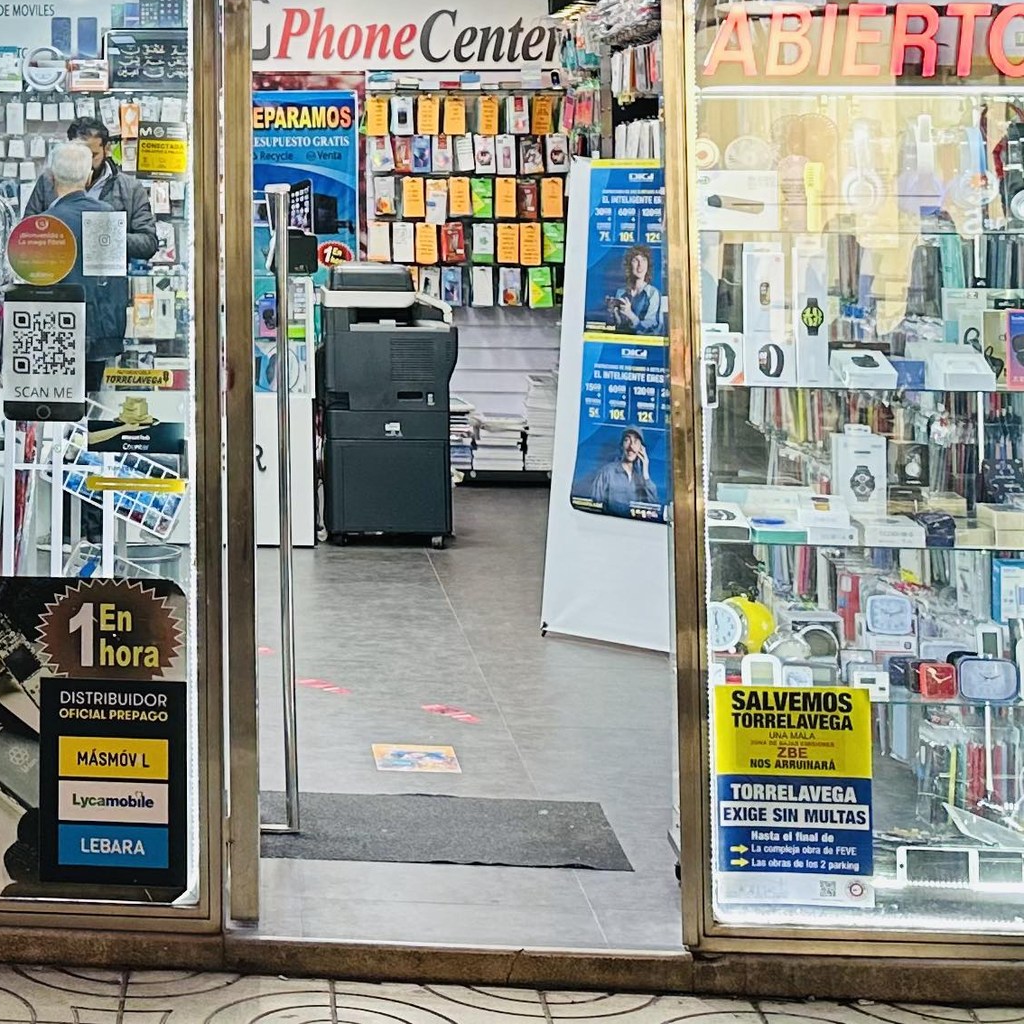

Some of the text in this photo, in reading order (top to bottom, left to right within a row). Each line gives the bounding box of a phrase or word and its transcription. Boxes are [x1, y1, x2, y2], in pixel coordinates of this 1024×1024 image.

[12, 4, 55, 17] MOVILES
[313, 135, 350, 147] GRATIS
[317, 151, 342, 161] Venta
[105, 375, 163, 384] TORRELAVEGA
[14, 385, 73, 400] SCAN ME
[100, 603, 132, 632] En
[69, 601, 96, 668] 1
[100, 638, 160, 669] hora
[60, 691, 168, 707] DISTRIBUIDOR
[731, 690, 853, 713] SALVEMOS
[59, 708, 169, 722] OFICIAL PREPAGO
[731, 713, 854, 731] TORRELAVEGA
[790, 732, 816, 740] MALA
[777, 747, 808, 759] ZBE
[750, 758, 836, 770] NOS ARRUINARÁ
[730, 783, 857, 803] TORRELAVEGA
[72, 792, 154, 809] Lycamobile
[723, 807, 867, 825] EXIGE SIN MULTAS
[751, 831, 835, 843] Hasta el final de
[80, 837, 146, 856] LEBARA
[751, 843, 857, 857] La compleja obra de FEVE
[751, 857, 860, 871] Las obras de los 2 parking
